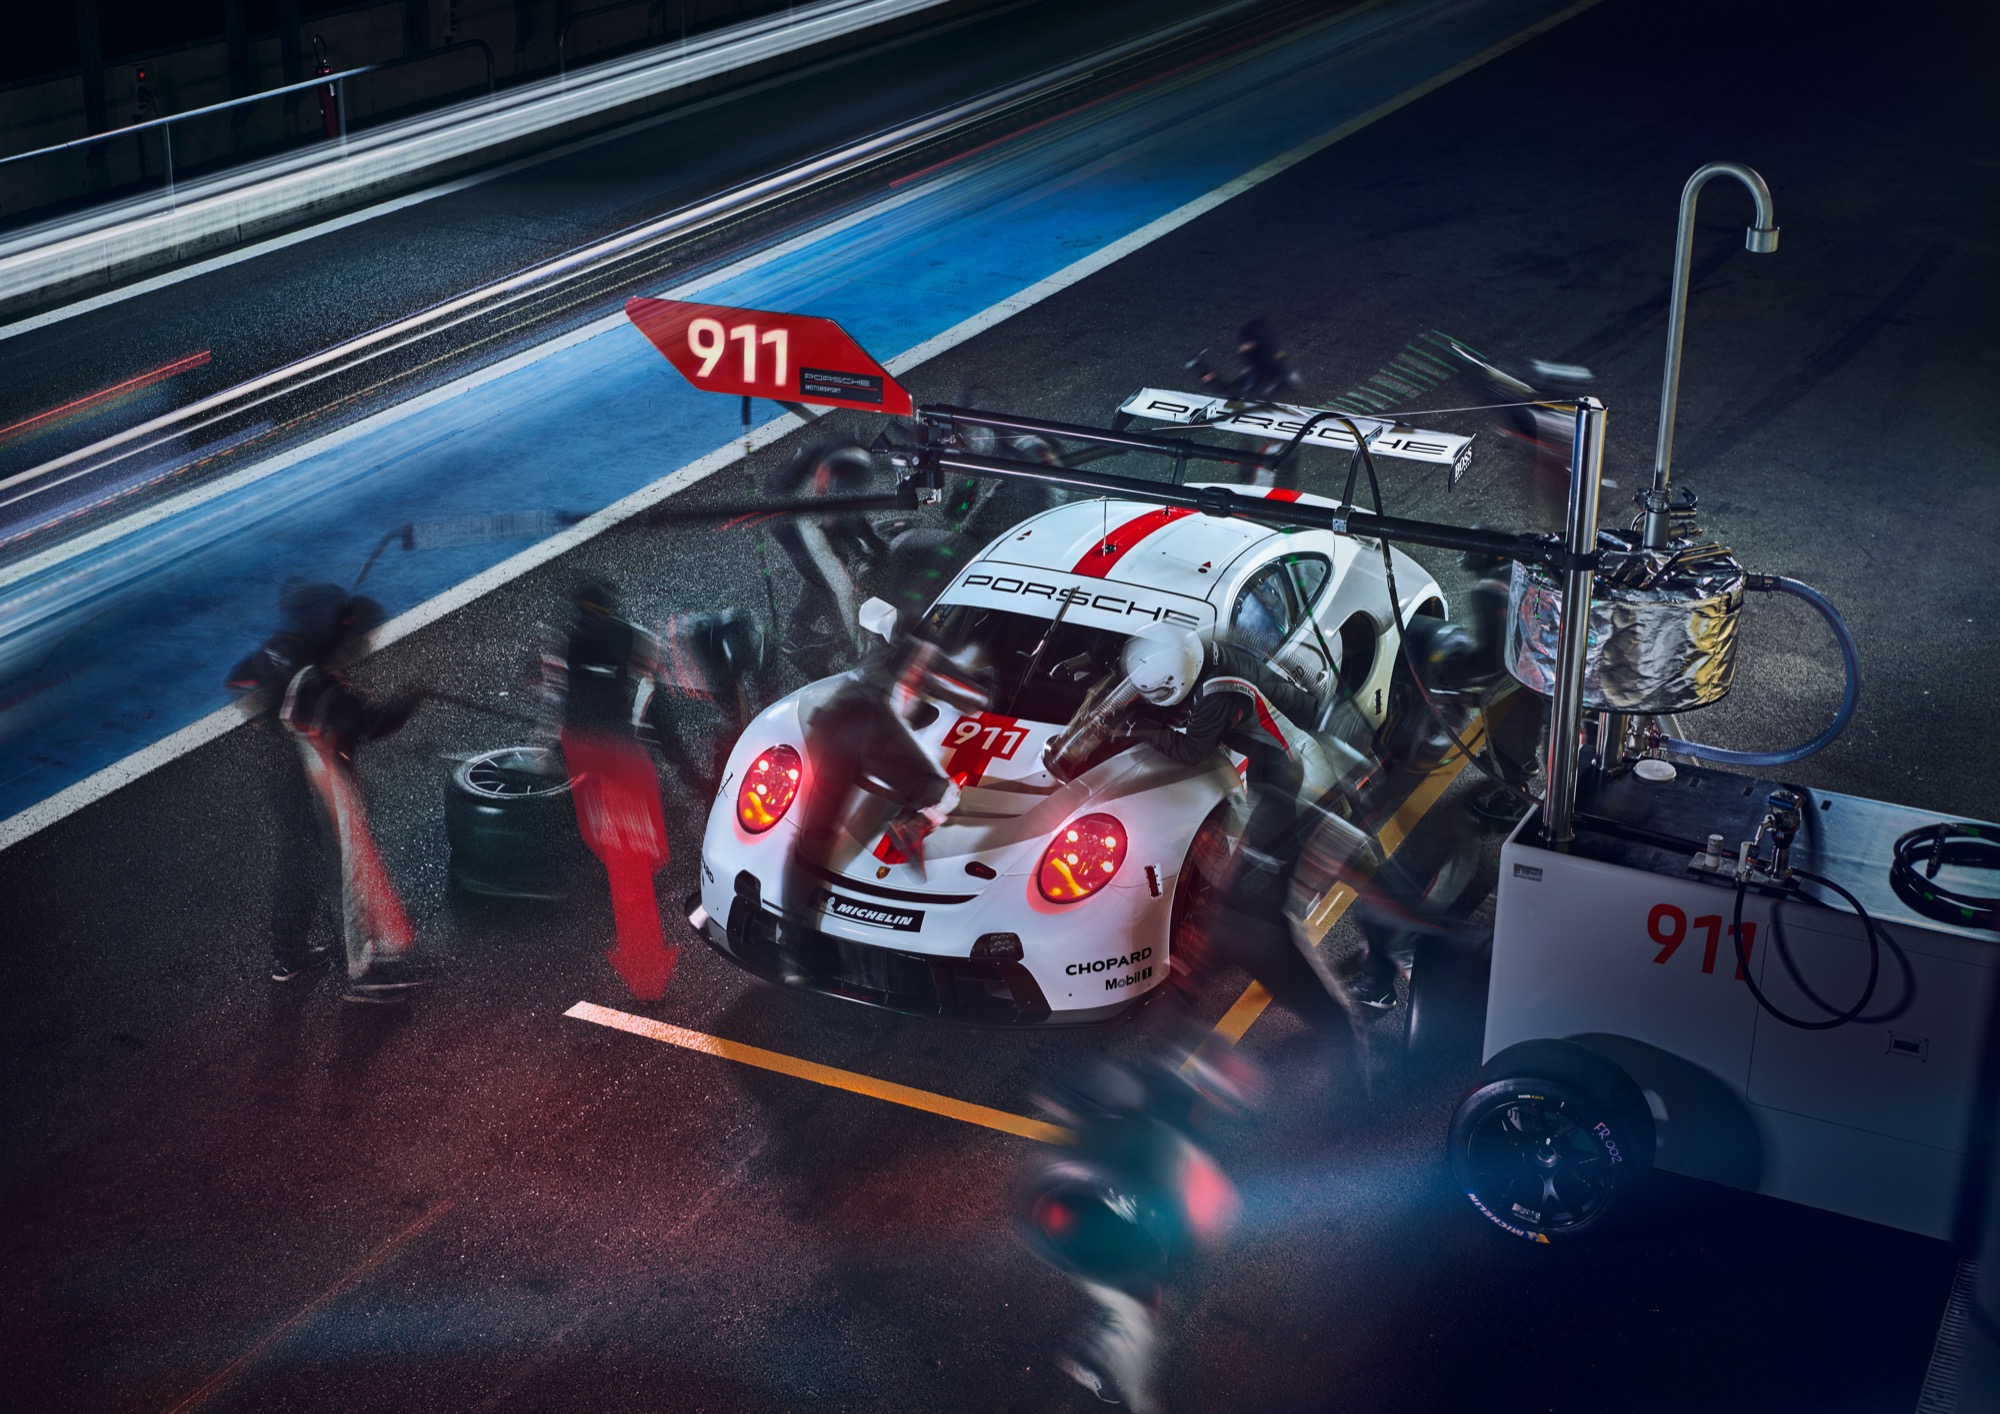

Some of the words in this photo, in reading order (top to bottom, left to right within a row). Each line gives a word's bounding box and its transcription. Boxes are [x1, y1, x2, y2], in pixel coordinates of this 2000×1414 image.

[687, 317, 788, 387] 911
[804, 373, 870, 387] PORSCHE
[804, 384, 842, 394] MOTORSPORT
[1454, 446, 1472, 479] BOSS
[961, 575, 1200, 630] PORSCHE
[953, 721, 1022, 755] 911
[836, 903, 913, 926] MICHELIN
[1647, 903, 1757, 981] 911
[1065, 946, 1152, 976] CHOPARD
[1105, 971, 1140, 991] Mobil
[1593, 1121, 1611, 1140] FR
[1605, 1140, 1623, 1165] 002
[1468, 1193, 1525, 1237] MICHELIN
